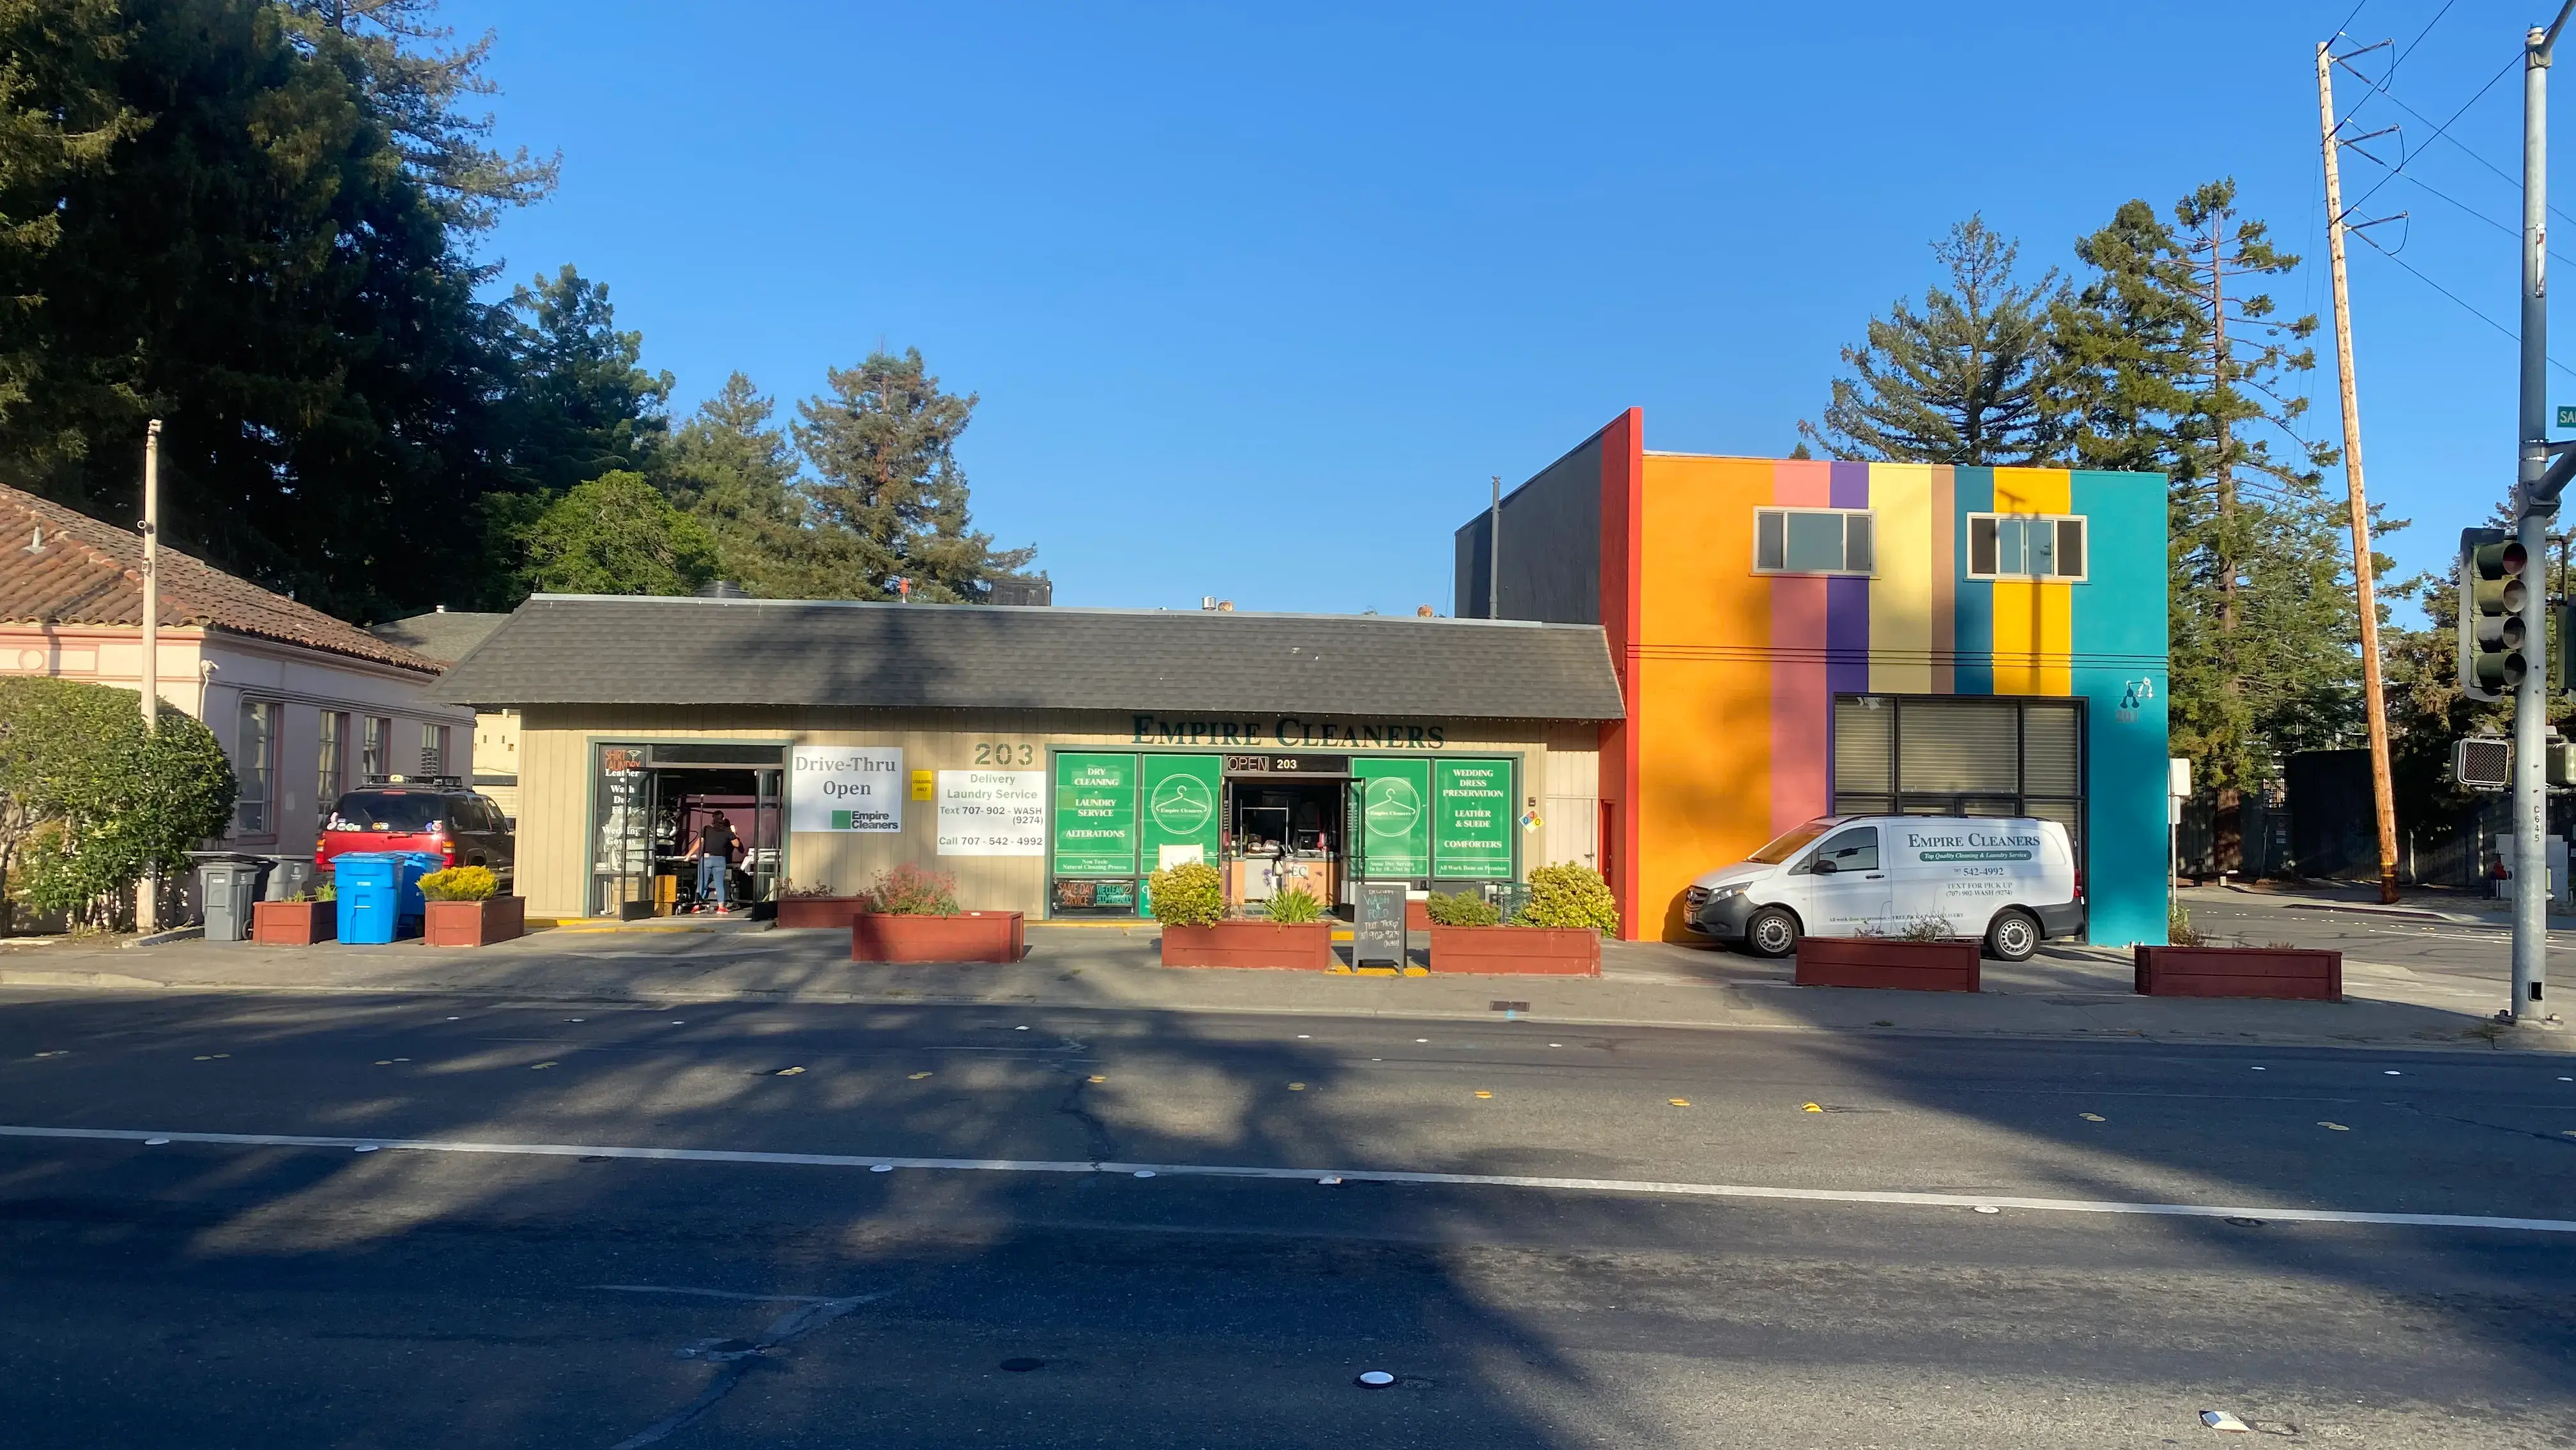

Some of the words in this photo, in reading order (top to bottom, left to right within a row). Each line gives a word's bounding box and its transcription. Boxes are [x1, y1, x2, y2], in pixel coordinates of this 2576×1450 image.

[2560, 410, 2576, 423] SA
[1131, 715, 1261, 746] EMPIRE
[1276, 718, 1444, 749] CLEANERS
[604, 750, 626, 760] SHIRT
[974, 743, 1033, 765] 203
[795, 757, 896, 772] Drive-Thru
[1228, 757, 1268, 771] OPEN
[1276, 759, 1297, 769] 203
[970, 774, 1015, 785] Delivery
[610, 785, 634, 793] Wah
[823, 780, 871, 799] Open
[1443, 789, 1503, 798] PRESERVATION
[947, 789, 992, 800] Laundry
[995, 789, 1038, 799] Service
[611, 806, 632, 814] Fod
[940, 806, 960, 815] Text
[986, 806, 1005, 815] 902
[852, 810, 889, 822] Empire
[1013, 816, 1043, 825] (9274)
[852, 820, 898, 829] Cleaners
[601, 826, 641, 837] Weding
[1066, 829, 1125, 838] ALTERATIONS
[939, 837, 958, 845] Call
[1016, 837, 1043, 845] 4992
[1907, 833, 1963, 847] EMPIRE
[1968, 833, 2040, 847] CLEANERS
[1291, 866, 1307, 876] EC
[1963, 867, 2004, 876] 542-4992
[1058, 883, 1077, 894] SAME
[1080, 883, 1094, 895] DAY
[1097, 885, 1106, 895] WE
[1106, 885, 1124, 895] CLEAN
[1062, 895, 1089, 905] SERVICE
[1363, 894, 1390, 905] WASH
[1367, 908, 1389, 919] FOLD
